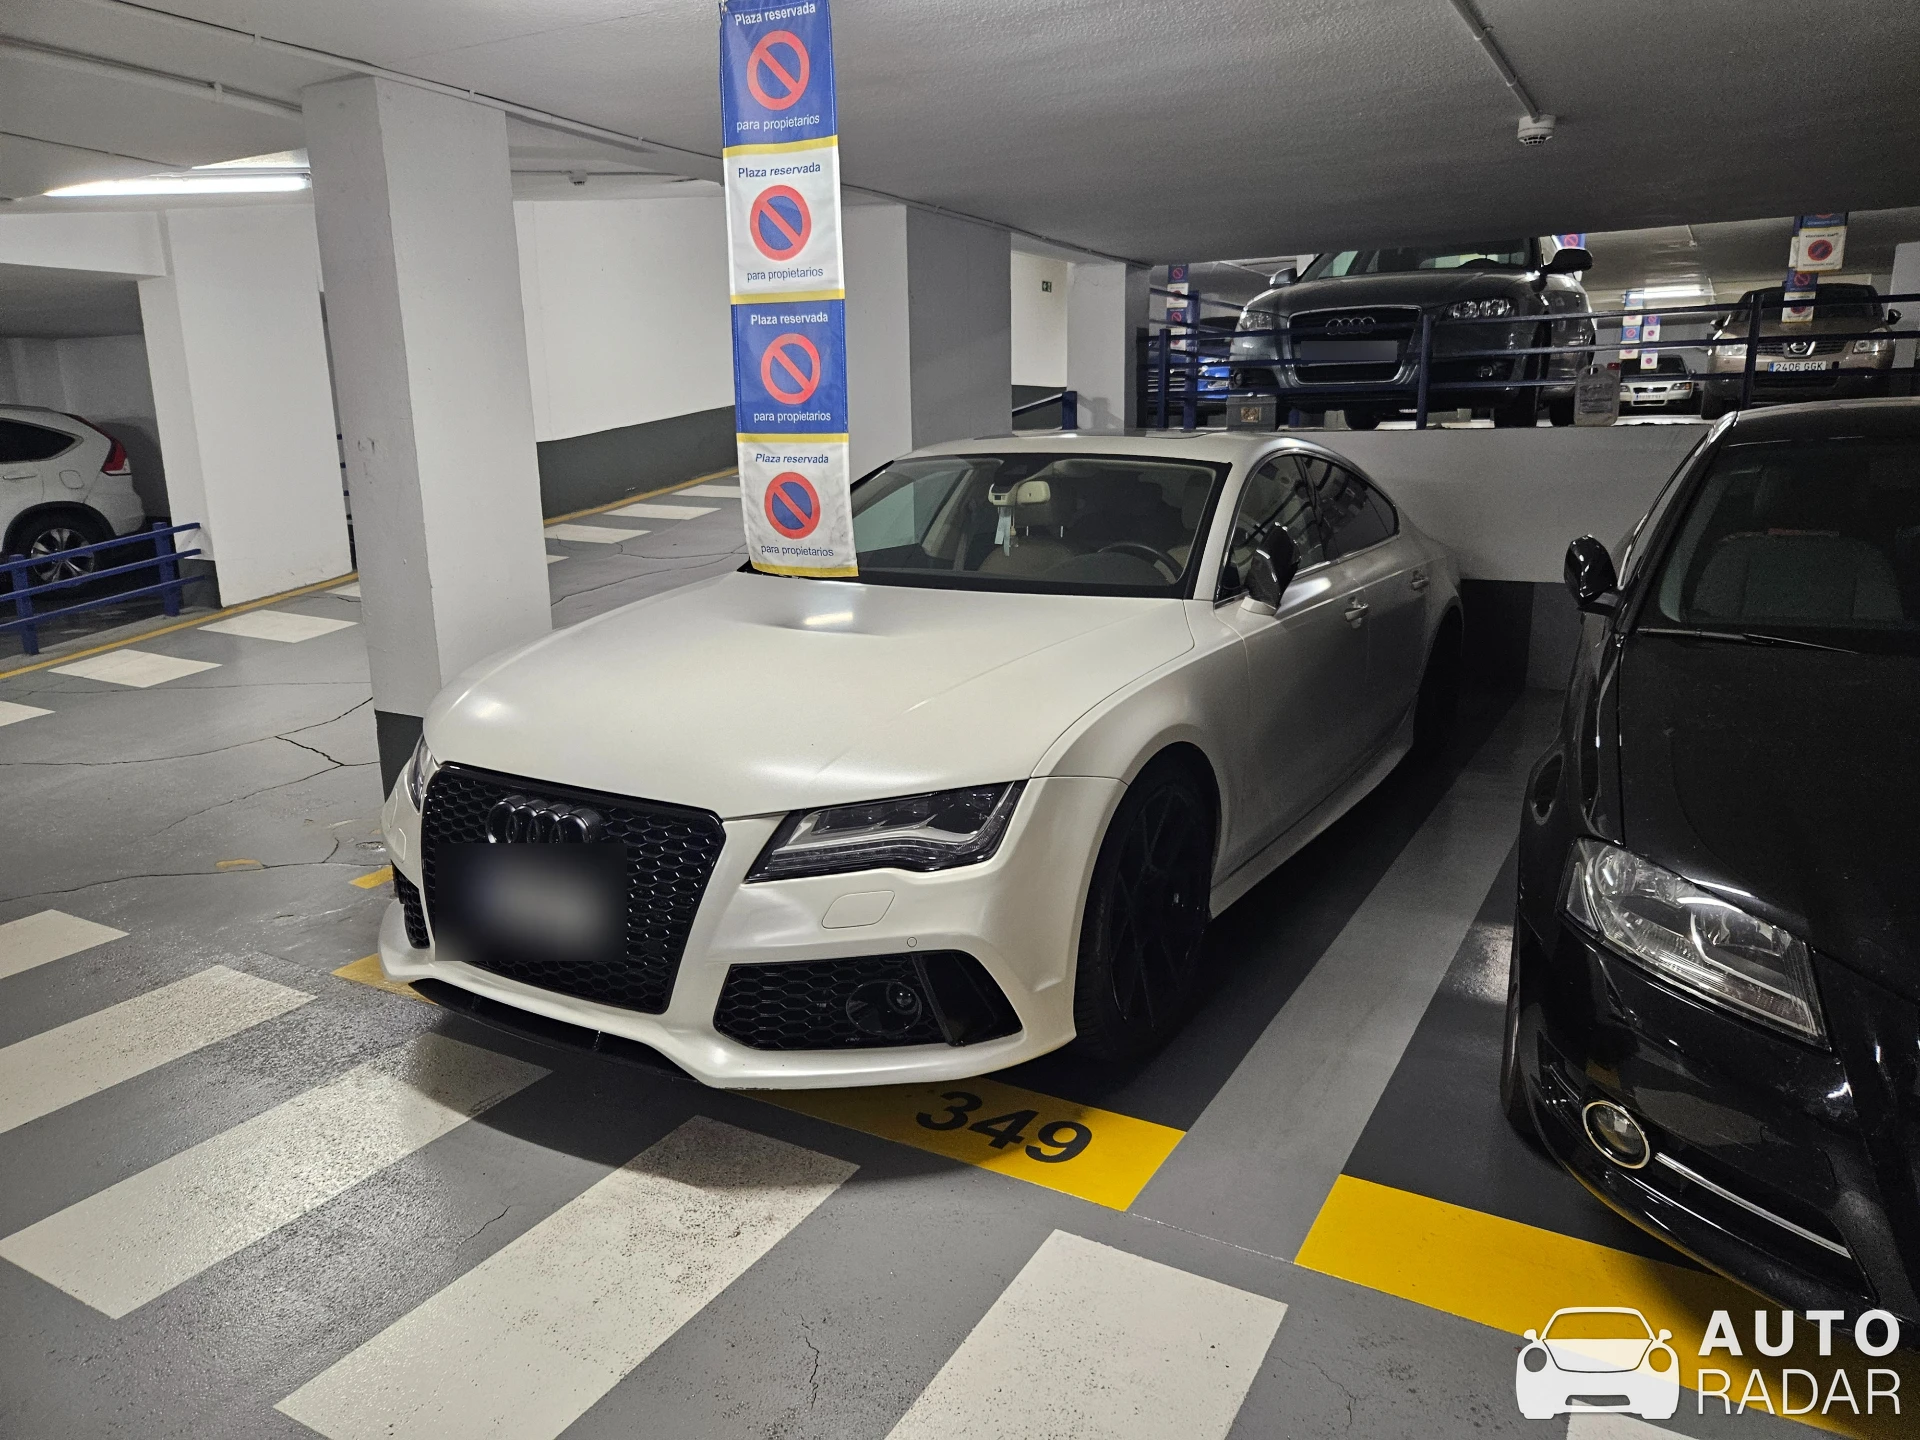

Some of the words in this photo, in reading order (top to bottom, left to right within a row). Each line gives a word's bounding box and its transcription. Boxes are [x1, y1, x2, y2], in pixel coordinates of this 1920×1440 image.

[734, 10, 763, 27] Plaza
[764, 2, 816, 22] reservada
[736, 118, 760, 132] para
[763, 113, 820, 131] propietarios
[738, 166, 767, 178] Plaza
[769, 162, 821, 177] reservada
[747, 271, 766, 283] para
[768, 267, 824, 282] propietarios
[750, 314, 778, 325] Plaza
[780, 312, 829, 324] reservada
[1775, 362, 1801, 371] 2406
[753, 412, 775, 424] para
[777, 410, 831, 424] propietarios
[755, 453, 781, 464] Plaza
[783, 453, 829, 464] reservada
[761, 544, 780, 555] para
[781, 545, 834, 557] propietarios
[916, 1091, 1093, 1163] 349
